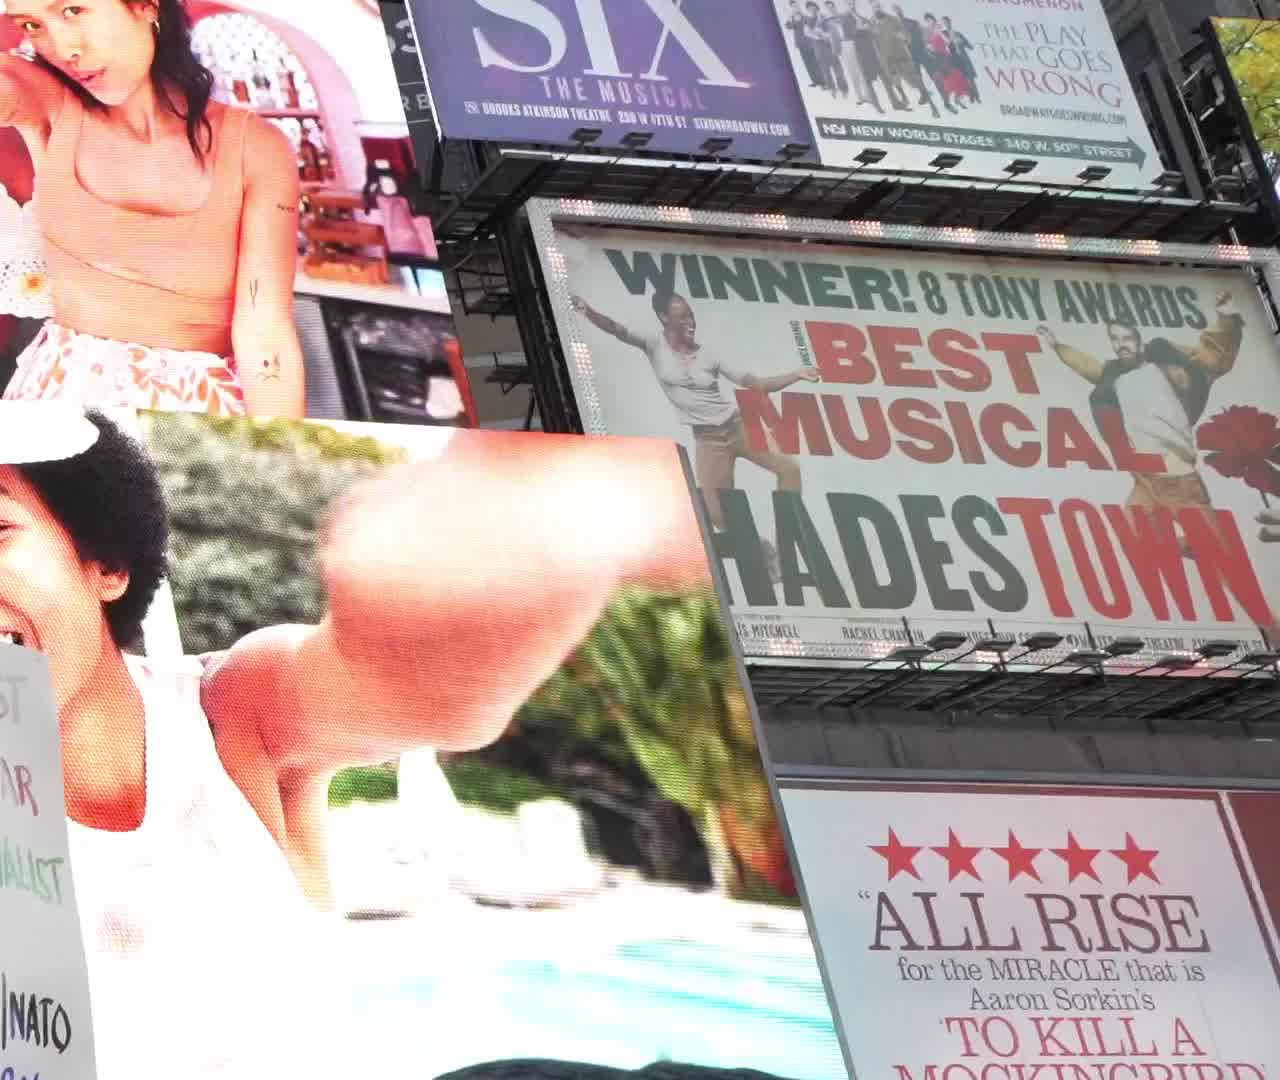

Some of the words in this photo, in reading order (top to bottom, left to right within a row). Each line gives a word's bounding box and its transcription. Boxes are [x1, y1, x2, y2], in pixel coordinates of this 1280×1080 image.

[473, 0, 752, 89] SIX
[1023, 22, 1087, 47] PLAY
[1036, 45, 1114, 73] GOES
[540, 75, 587, 101] THE
[598, 80, 708, 110] MUSICAL
[984, 65, 1121, 109] WRONG
[570, 108, 612, 123] THEATRE
[852, 125, 884, 138] NEW
[887, 127, 940, 142] WORLD
[603, 248, 915, 313] WINNER!
[923, 276, 949, 315] 8
[946, 272, 1044, 322] TONY
[1053, 279, 1209, 330] AWARDS
[805, 320, 1041, 395] BEST
[735, 388, 1167, 473] MUSICAL
[710, 487, 1277, 625] HADESTOWN
[1025, 891, 1211, 954] RISE
[896, 956, 935, 982] for
[939, 957, 983, 982] the
[986, 957, 1119, 982] MIRACLE
[1123, 957, 1178, 983] that
[1183, 959, 1205, 983] is
[970, 988, 1049, 1012] Aaron
[1055, 987, 1156, 1012] Sorkin's
[1029, 1016, 1159, 1058] KILL
[1172, 1016, 1208, 1057] A
